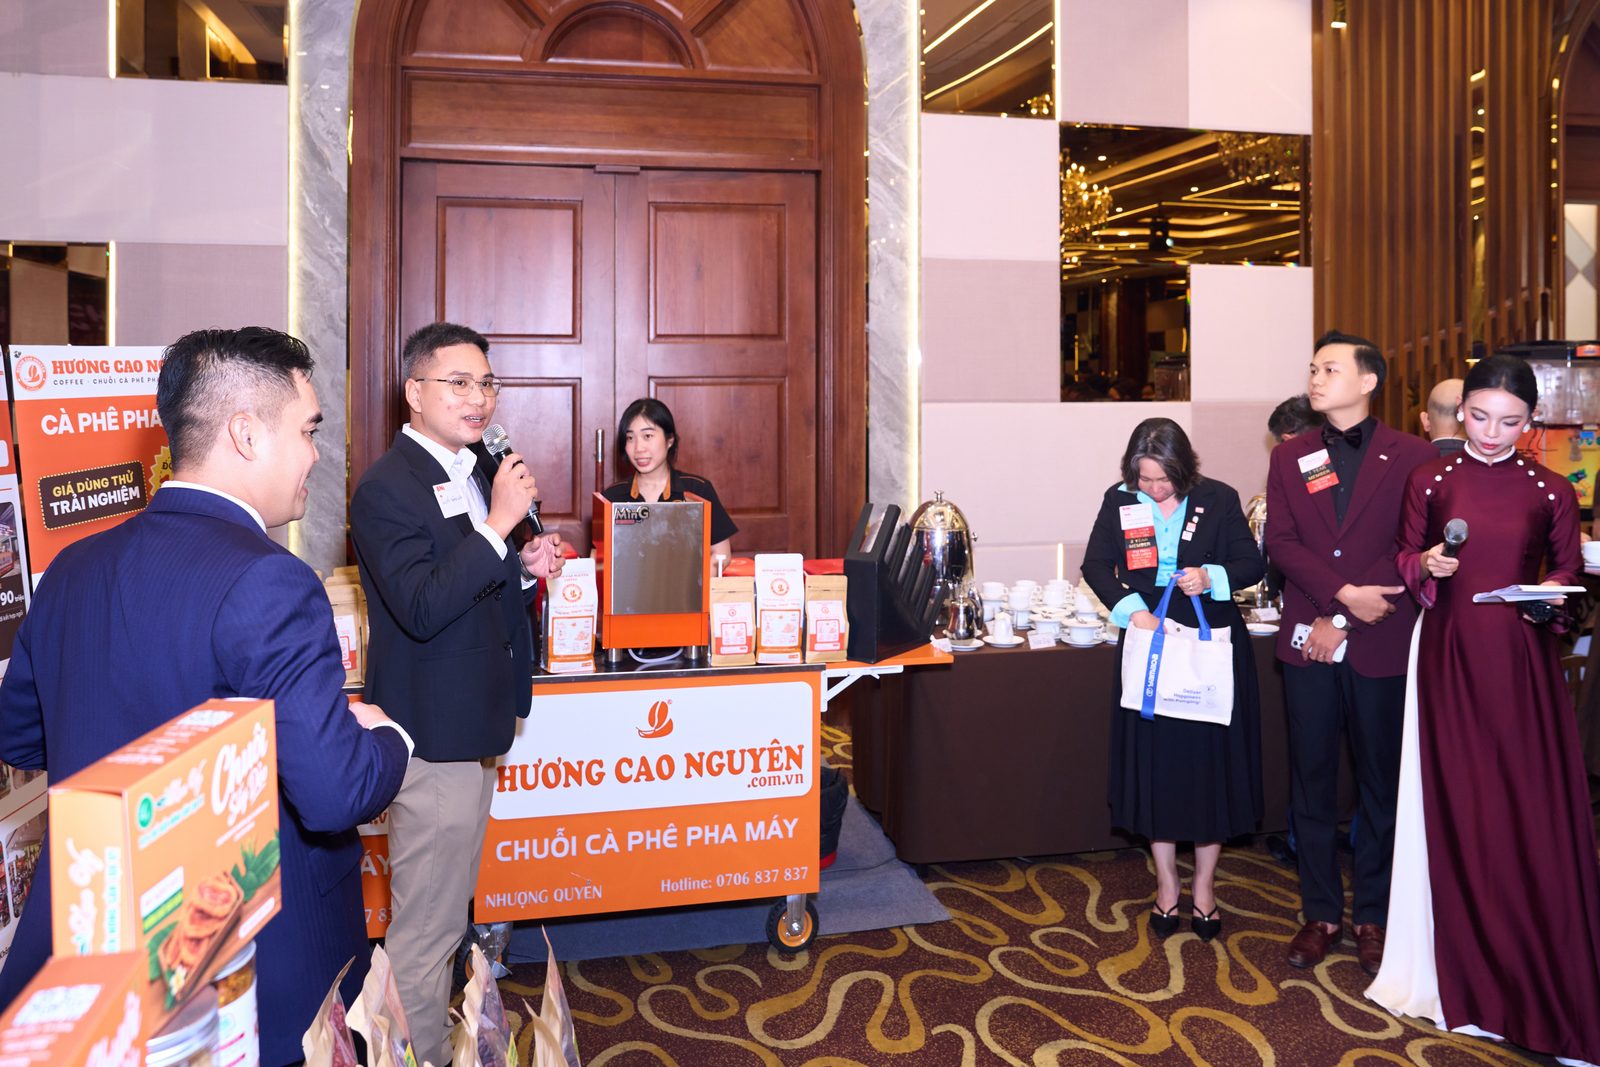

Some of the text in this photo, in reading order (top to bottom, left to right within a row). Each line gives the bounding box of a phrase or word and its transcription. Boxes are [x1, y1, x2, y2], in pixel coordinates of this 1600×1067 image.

[52, 358, 110, 375] HƯƠNG
[114, 359, 143, 373] CAO
[41, 405, 164, 435] CÀ PHÊ PHA
[52, 469, 134, 497] GIÁ DÙNG THỬ
[49, 485, 141, 516] TRẢI NGHIỆM
[496, 738, 805, 793] HƯƠNG CAO NGUYÊN
[747, 773, 804, 788] .com.vn
[496, 814, 799, 862] CHUỖI CÀ PHÊ PHA MÁY
[361, 850, 390, 877] ÁY
[660, 866, 809, 893] Hotline: 0706 837 837
[485, 889, 549, 909] NHƯỢNG
